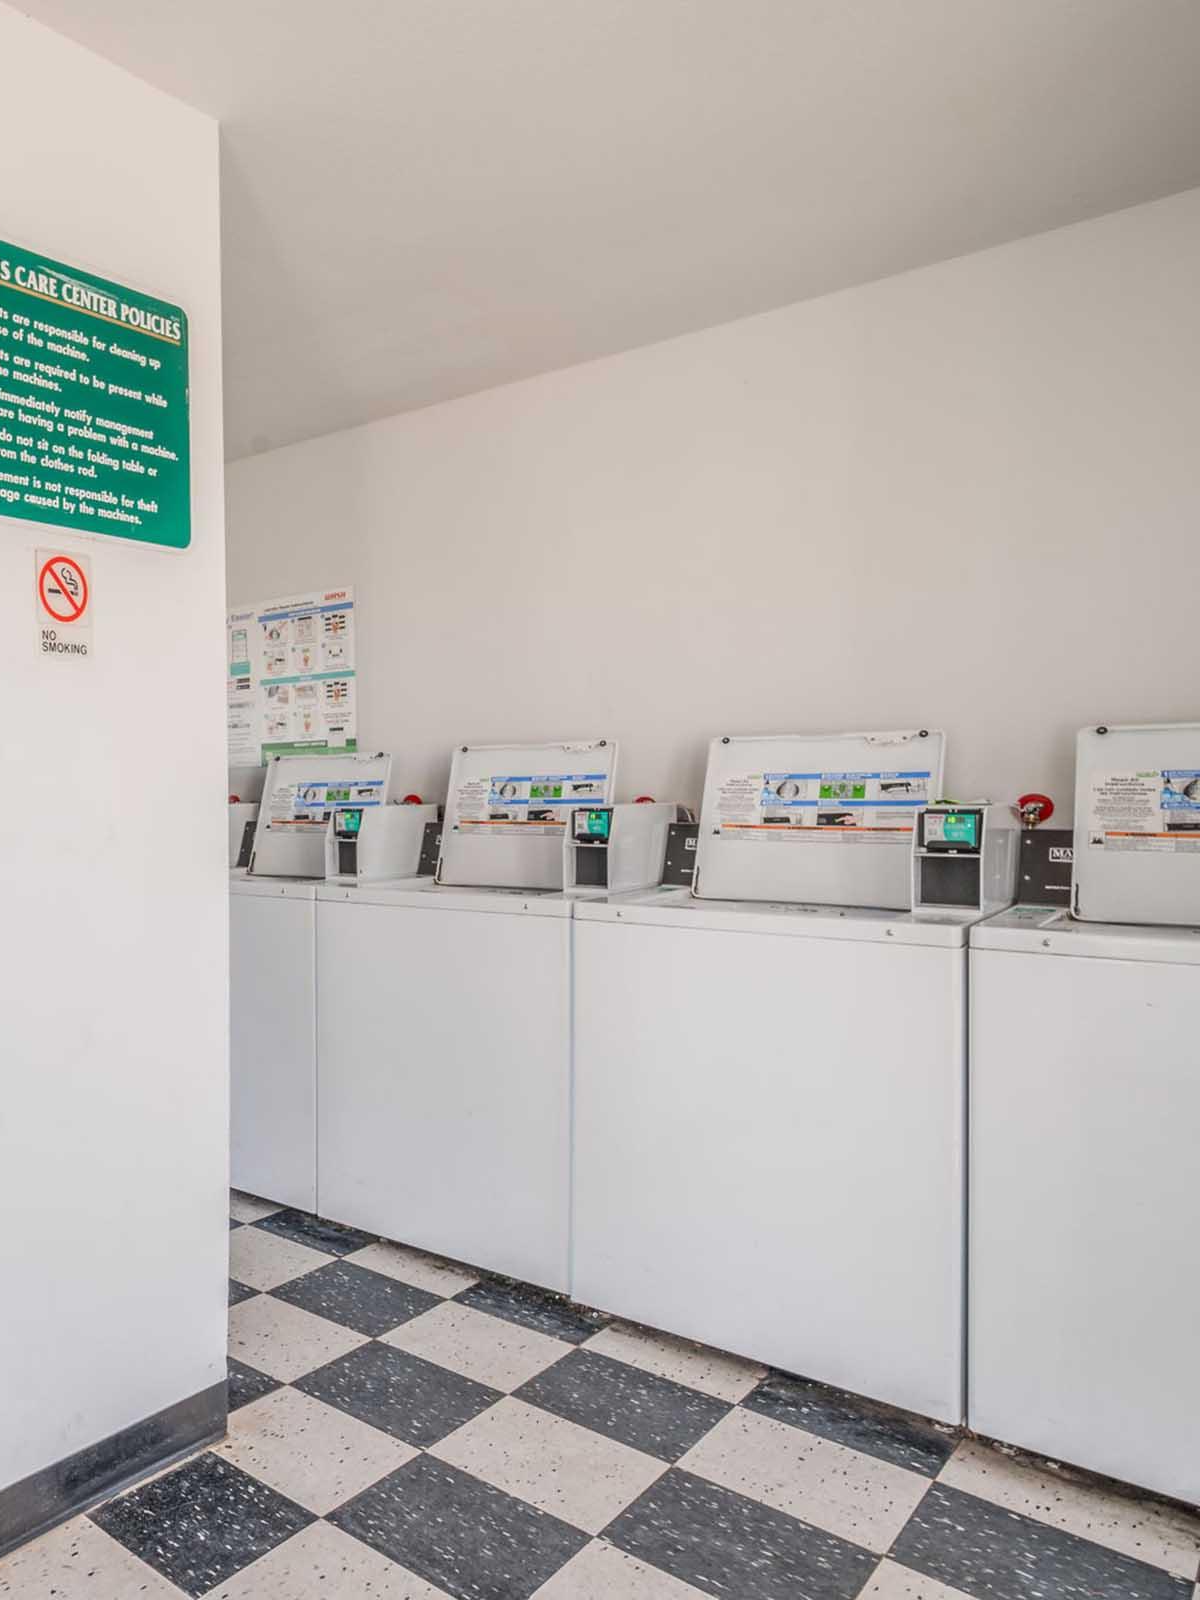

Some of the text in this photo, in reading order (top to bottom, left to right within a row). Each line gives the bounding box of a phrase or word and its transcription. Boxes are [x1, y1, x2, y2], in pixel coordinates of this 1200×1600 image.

[15, 266, 58, 298] CARE
[62, 283, 117, 320] CENTER
[121, 303, 180, 340] POLICIES
[12, 314, 30, 326] are
[34, 321, 88, 345] responsible
[92, 336, 106, 350] for
[110, 344, 146, 366] cleaning
[149, 359, 160, 370] up
[12, 329, 23, 340] of
[28, 333, 43, 347] the
[48, 342, 89, 361] machine.
[13, 371, 62, 392] machines.
[14, 356, 30, 367] are
[35, 362, 76, 380] required
[80, 374, 90, 384] to
[93, 376, 105, 389] be
[108, 384, 142, 400] present
[145, 394, 167, 407] while
[18, 409, 53, 432] having
[57, 424, 64, 432] a
[68, 426, 106, 442] problem
[110, 436, 128, 448] with
[132, 442, 138, 450] a
[141, 445, 178, 460] machine.
[64, 409, 92, 425] notify
[96, 418, 153, 439] management
[0, 428, 12, 442] do
[16, 436, 33, 446] not
[38, 439, 48, 450] sit
[52, 445, 65, 454] on
[68, 446, 84, 459] the
[88, 449, 119, 470] folding
[122, 460, 144, 473] table
[148, 468, 157, 476] or
[20, 450, 36, 464] the
[41, 455, 74, 472] clothes
[78, 466, 97, 477] rod.
[24, 494, 59, 508] caused
[63, 498, 75, 513] by
[80, 502, 94, 514] the
[98, 509, 142, 524] machines.
[33, 476, 41, 488] is
[45, 482, 61, 492] not
[65, 487, 118, 504] responsible
[122, 495, 134, 508] for
[138, 499, 158, 512] theft
[41, 629, 57, 641] NO
[41, 641, 88, 656] SMOKING
[1052, 849, 1072, 857] MA
